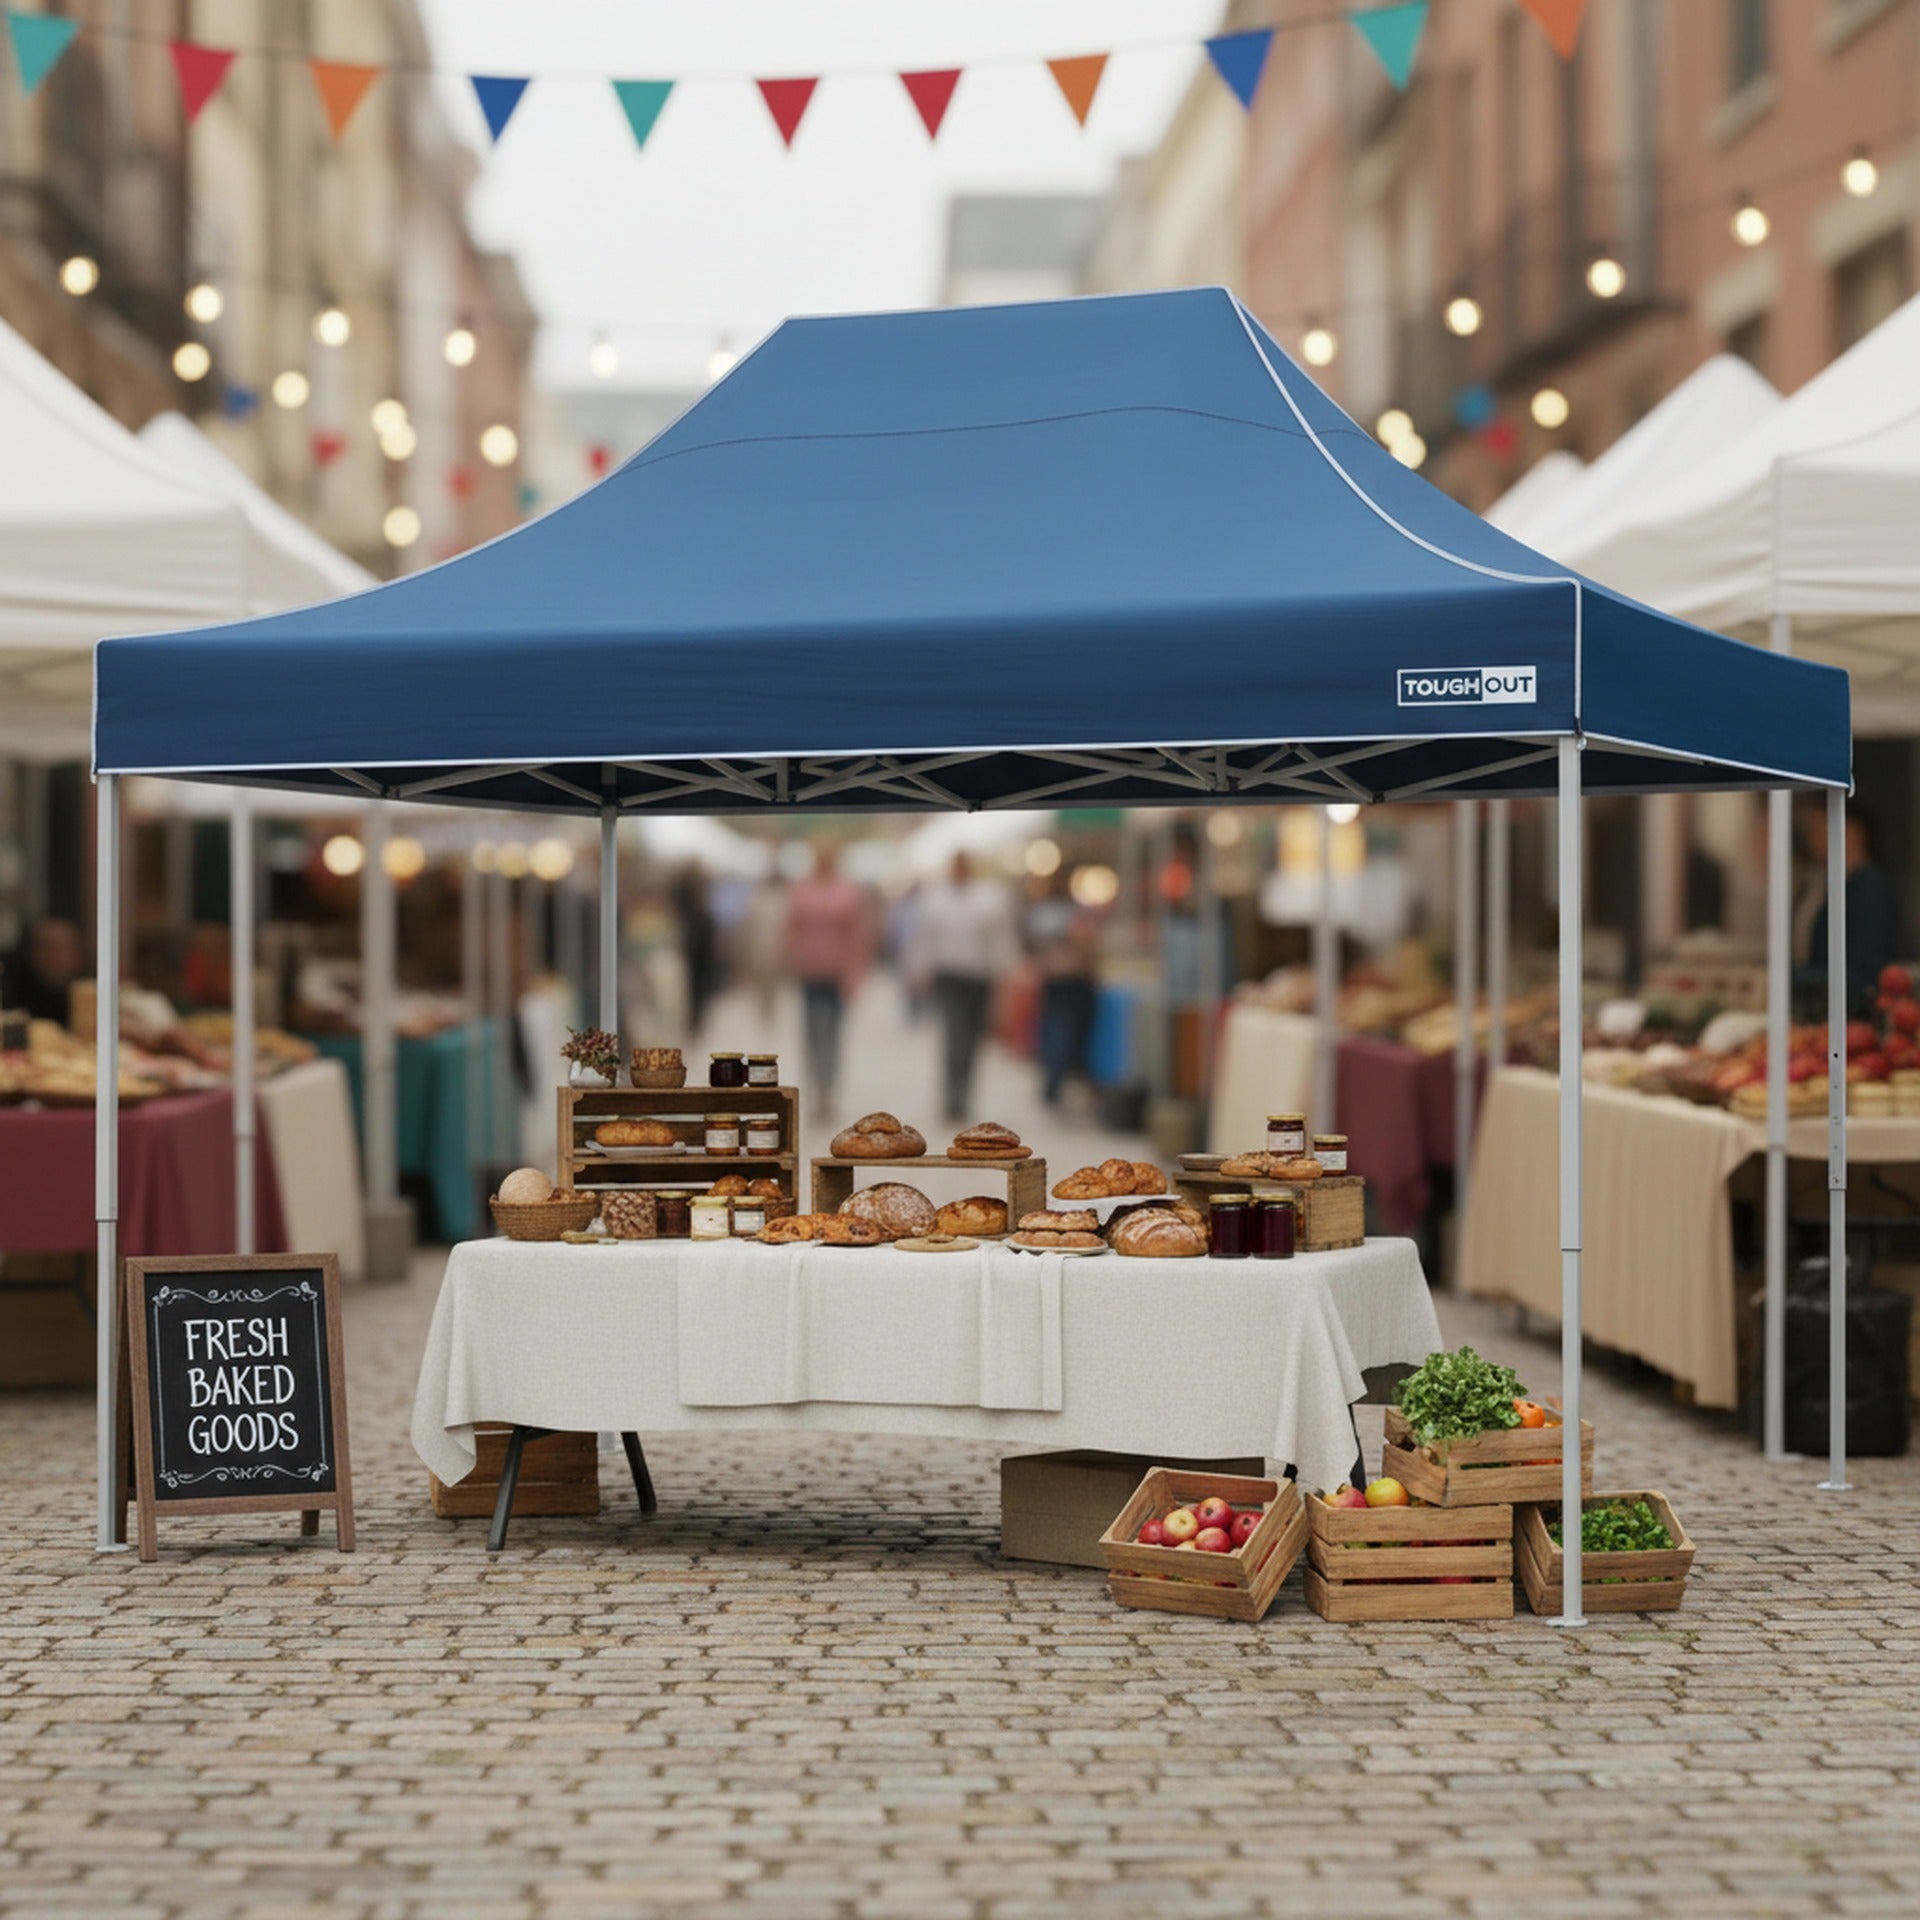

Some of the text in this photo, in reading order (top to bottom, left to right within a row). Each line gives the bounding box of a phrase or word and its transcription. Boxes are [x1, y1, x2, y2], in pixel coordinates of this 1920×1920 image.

[183, 1317, 289, 1361] FRESH
[187, 1364, 295, 1408] BAKED
[188, 1411, 299, 1455] GOODS
